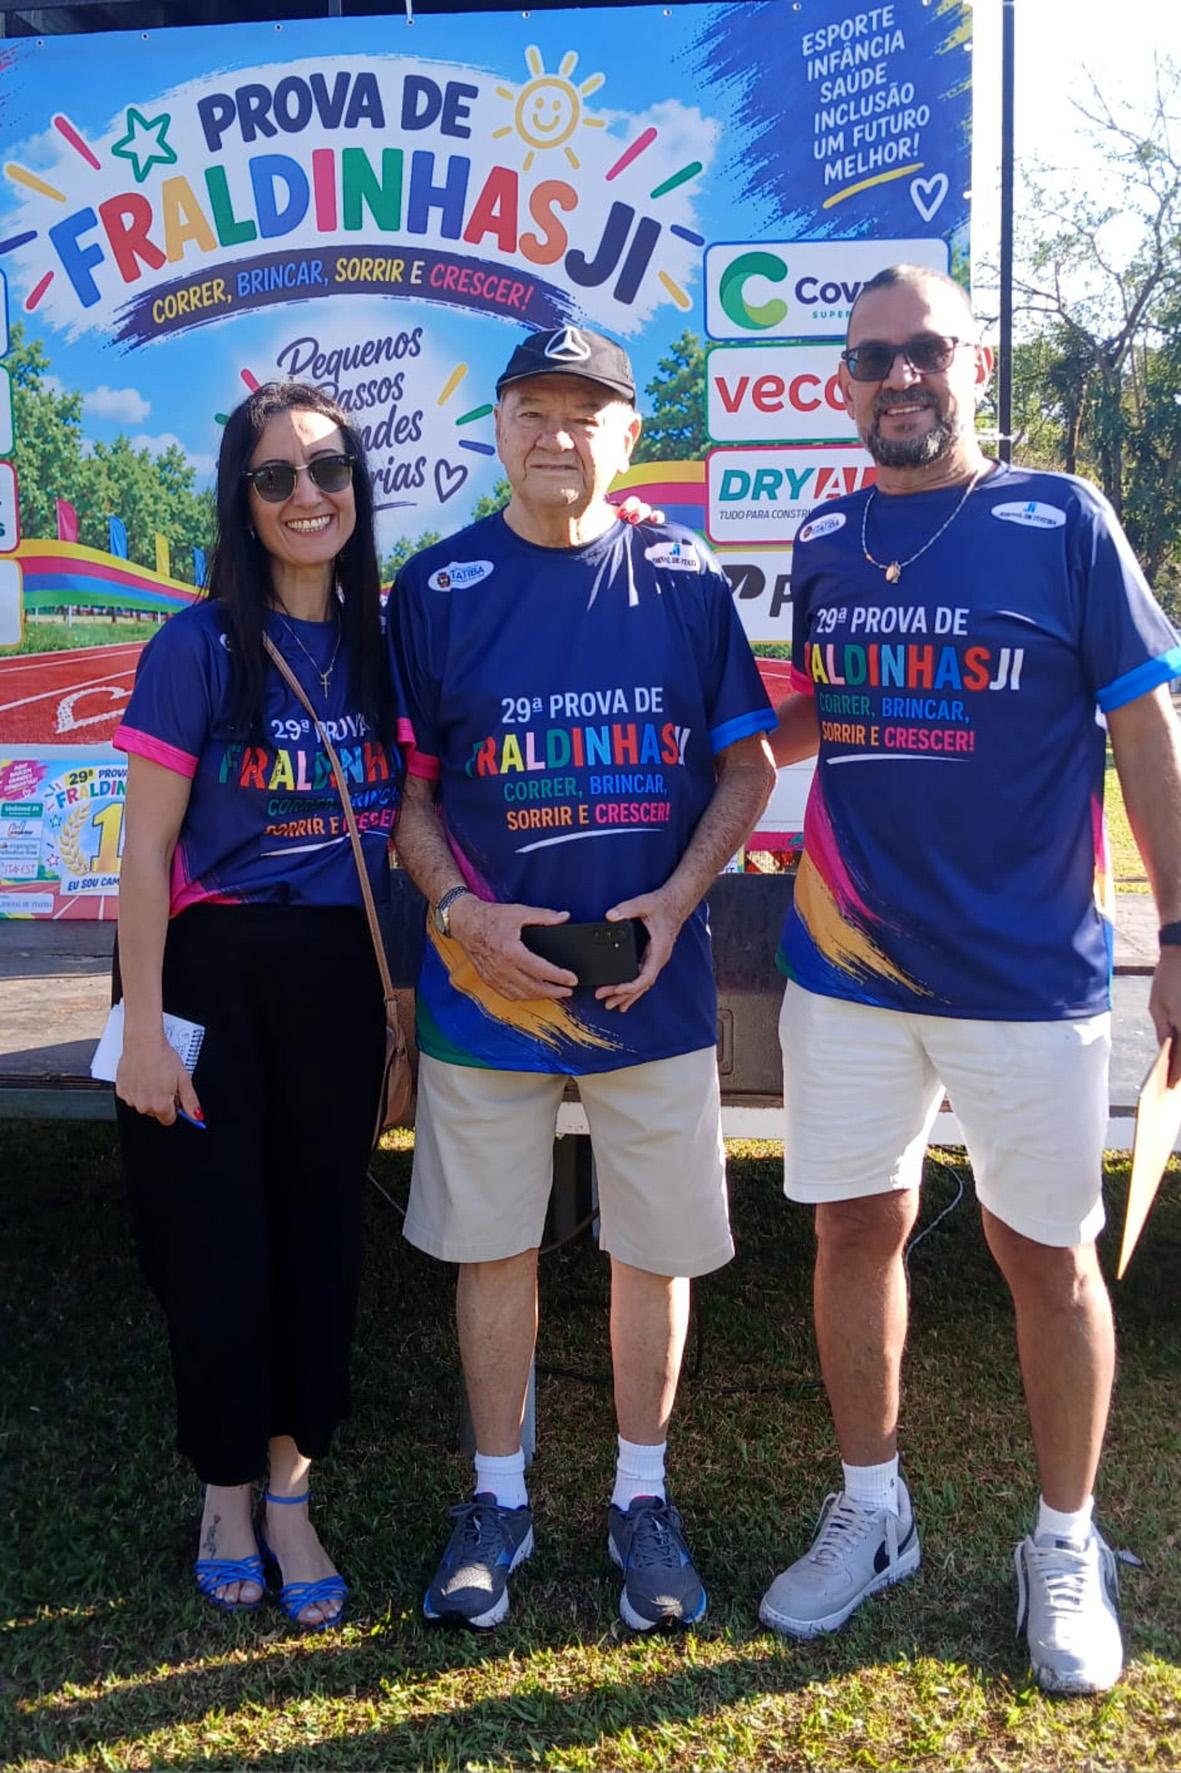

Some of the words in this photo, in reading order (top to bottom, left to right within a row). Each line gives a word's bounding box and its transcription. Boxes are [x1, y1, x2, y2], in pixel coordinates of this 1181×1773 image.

[801, 4, 895, 56] ESPORTE
[807, 30, 905, 81] INFÂNCIA
[820, 62, 887, 103] SAÚDE
[197, 71, 385, 152] PROVA
[400, 75, 479, 139] DE
[814, 82, 914, 134] INCLUSÃO
[813, 134, 845, 159] UM
[853, 105, 930, 148] FUTURO
[824, 132, 920, 186] MELHOR!
[152, 279, 233, 324] CORRER,
[236, 260, 329, 297] BRINCAR,
[335, 257, 404, 283] SORRIR
[410, 260, 423, 284] E
[429, 263, 534, 312] CRESCER!
[795, 277, 871, 304] Cov
[277, 327, 423, 382] Pequenos
[720, 510, 744, 520] TUDO
[745, 510, 770, 520] PARA
[816, 607, 847, 634] 29ª
[850, 606, 928, 634] PROVA
[934, 607, 969, 636] DE
[501, 697, 543, 724] 29ª
[549, 688, 629, 719] PROVA
[634, 687, 664, 713] DE
[881, 696, 971, 724] BRINCAR,
[271, 718, 310, 741] 29ª
[821, 720, 865, 746] SORRIR
[870, 726, 880, 746] E
[884, 726, 975, 752] CRESCER!
[503, 776, 583, 802] CORRER,
[590, 774, 668, 796] BRINCAR,
[506, 805, 573, 831] SORRIR
[579, 804, 590, 825] E
[595, 802, 671, 825] CRESCER!
[68, 880, 80, 891] EU
[81, 877, 99, 889] SOU
